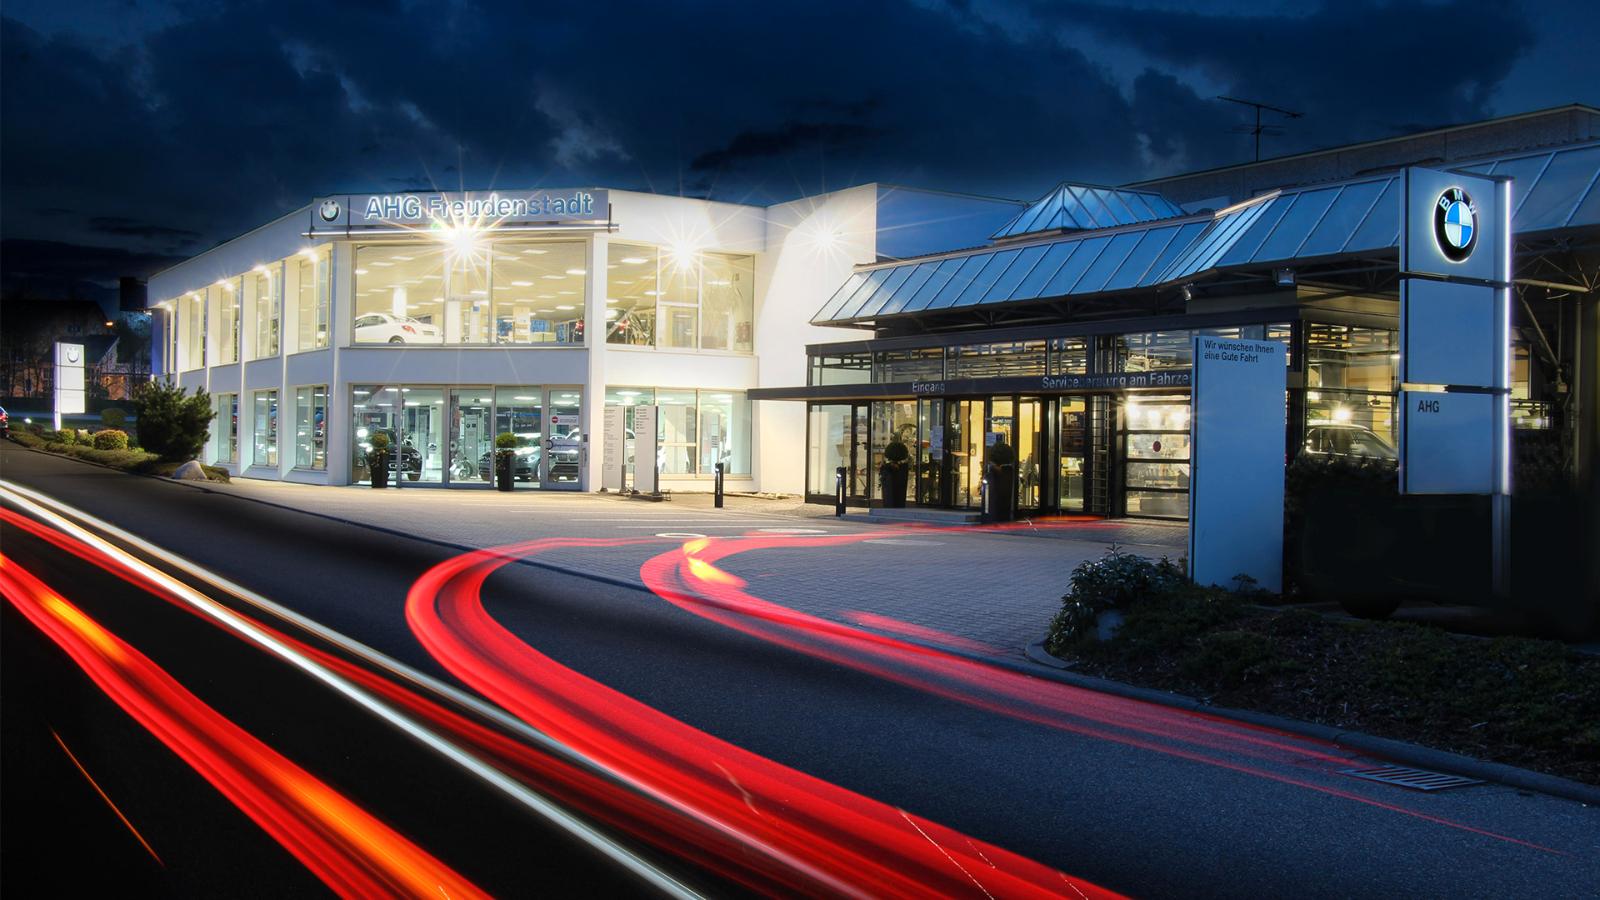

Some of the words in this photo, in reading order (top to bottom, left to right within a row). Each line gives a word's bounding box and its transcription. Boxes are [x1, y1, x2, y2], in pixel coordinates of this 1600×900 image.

[365, 196, 421, 220] AHG
[427, 192, 593, 217] Freudenstadt
[1439, 189, 1476, 215] BMW
[1204, 340, 1216, 349] Wir
[1255, 342, 1274, 353] Ihnen
[1204, 351, 1219, 360] eine
[1221, 352, 1238, 361] Gute
[1240, 352, 1259, 363] Fahrt
[1129, 375, 1147, 386] am
[1150, 372, 1192, 385] Fahrze
[912, 382, 945, 393] Eingang
[1417, 400, 1440, 413] AHG
